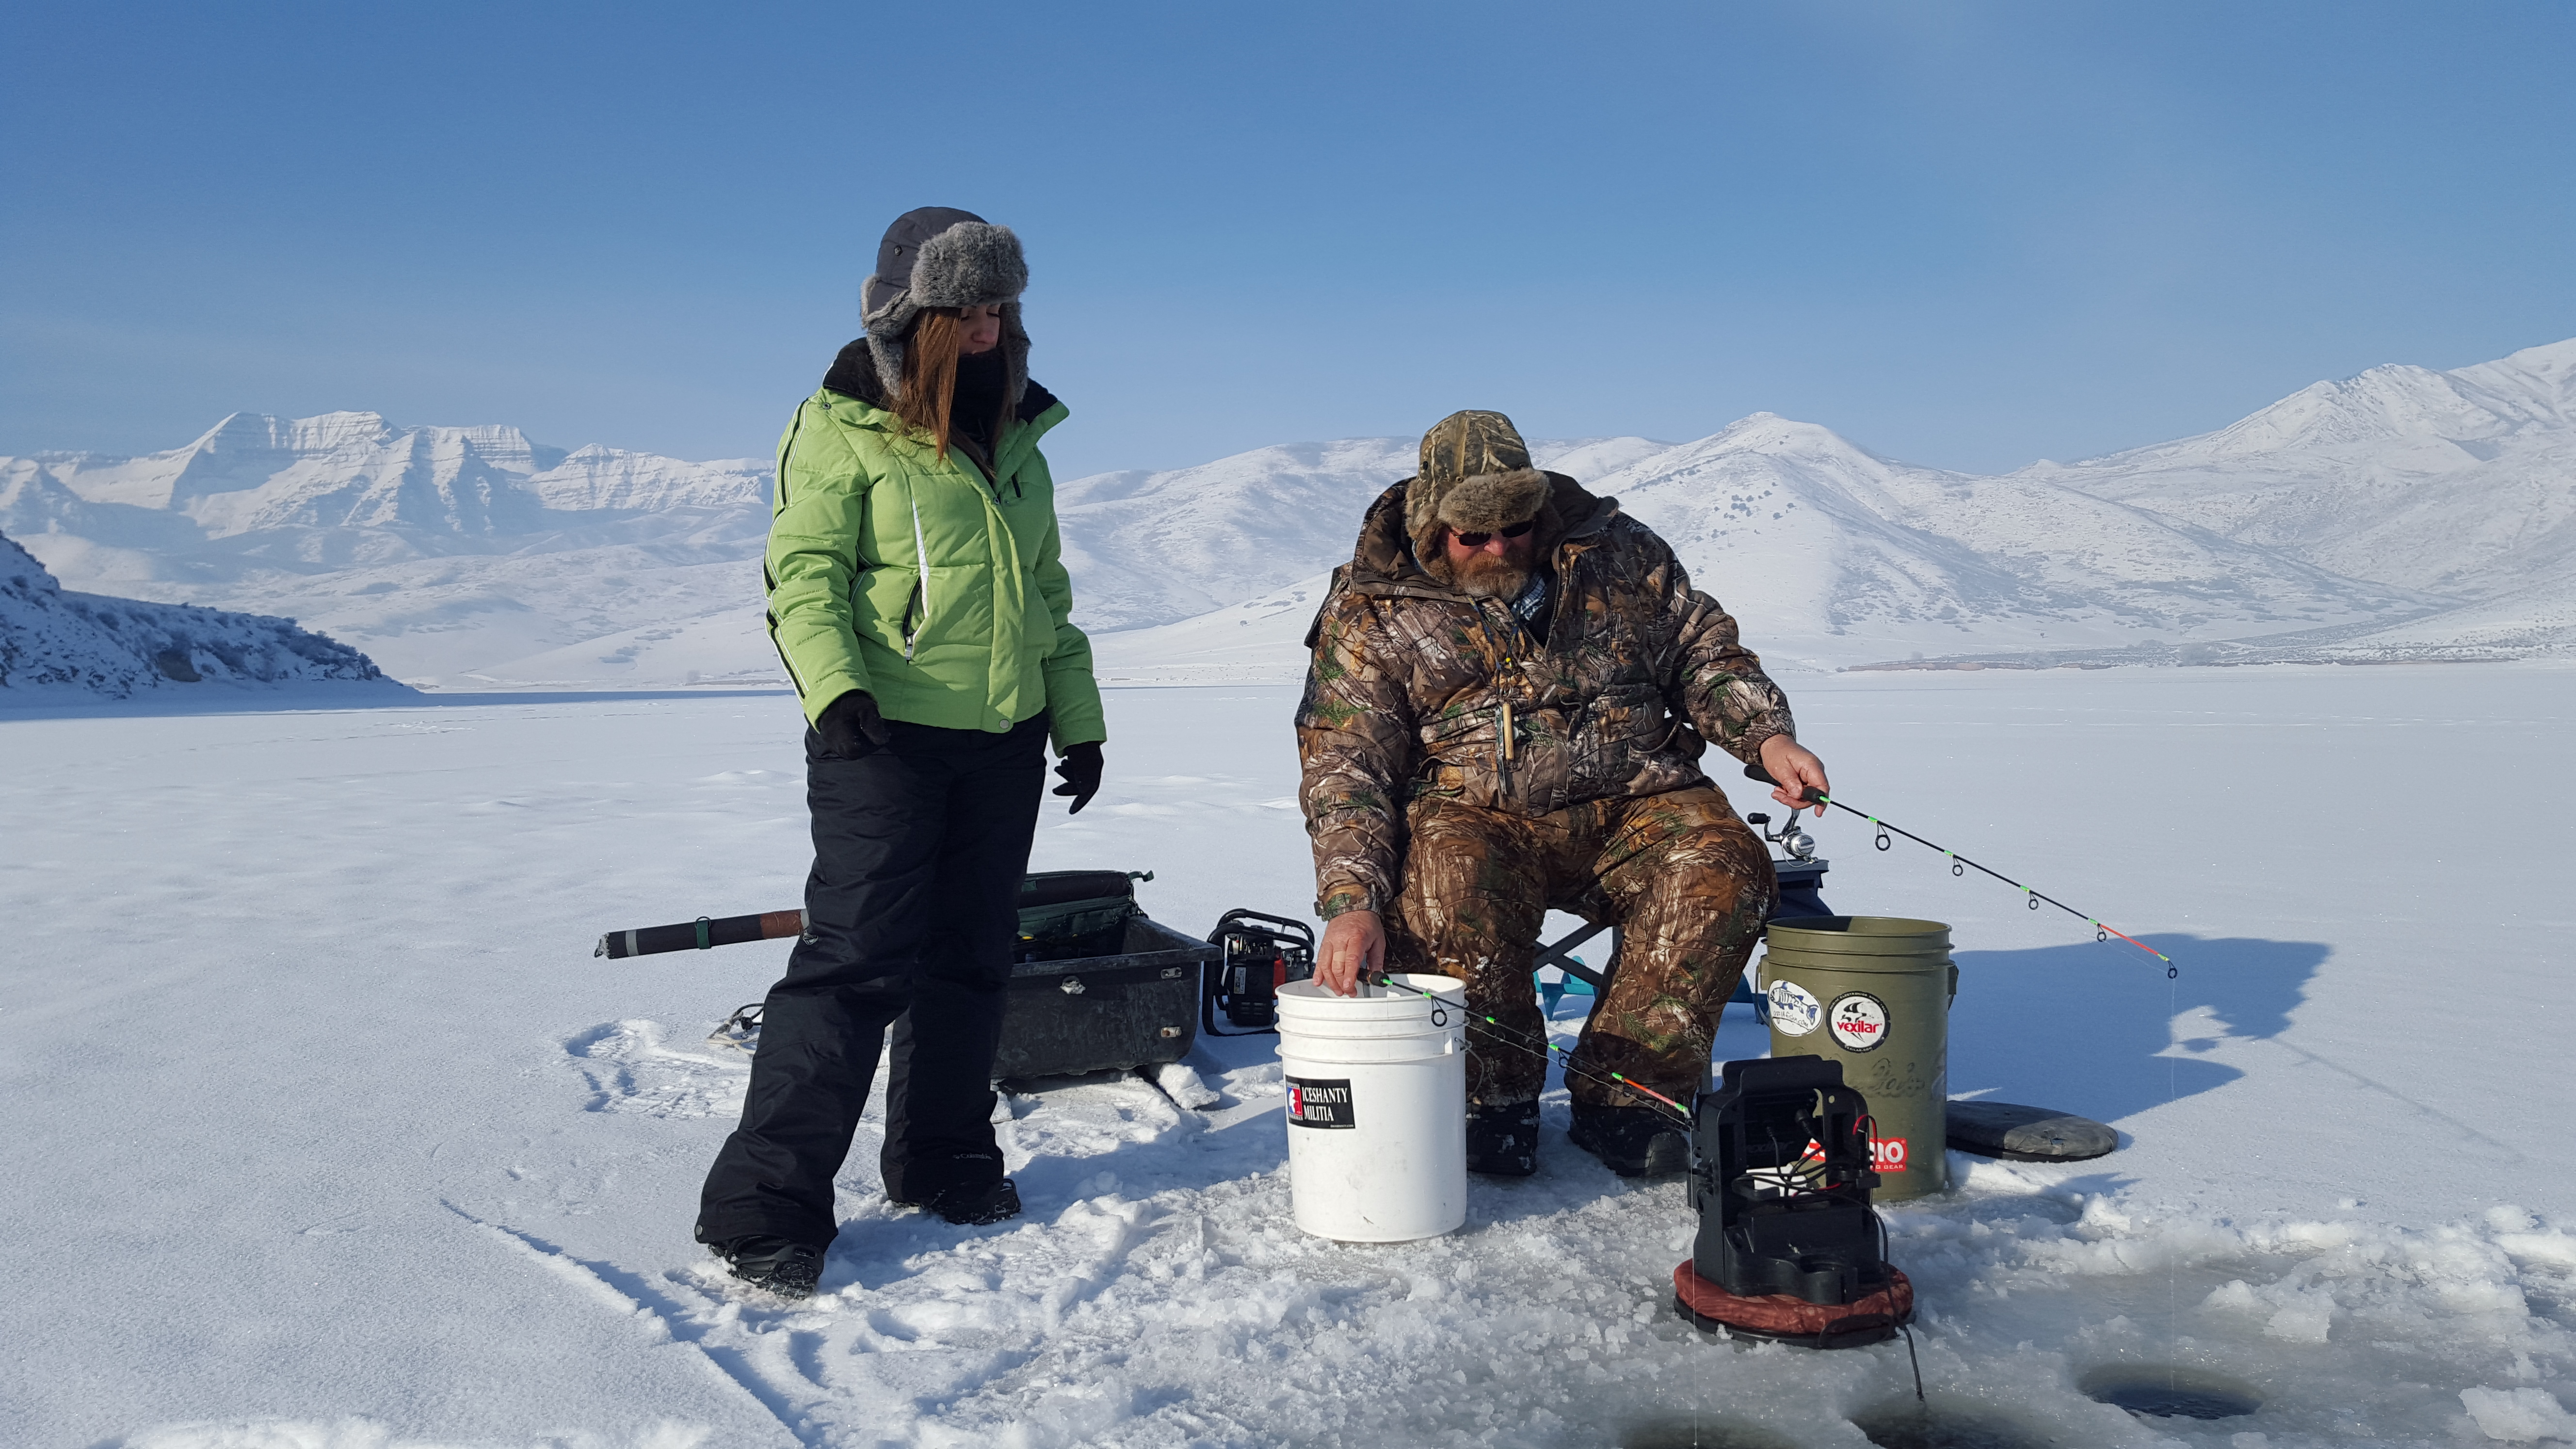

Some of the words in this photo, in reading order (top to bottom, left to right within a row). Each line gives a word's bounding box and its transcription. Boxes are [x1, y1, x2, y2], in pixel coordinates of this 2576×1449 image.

[1836, 1020, 1880, 1033] vexilar
[1302, 1086, 1348, 1103] ICESHANTY
[1303, 1104, 1335, 1121] MILITIA
